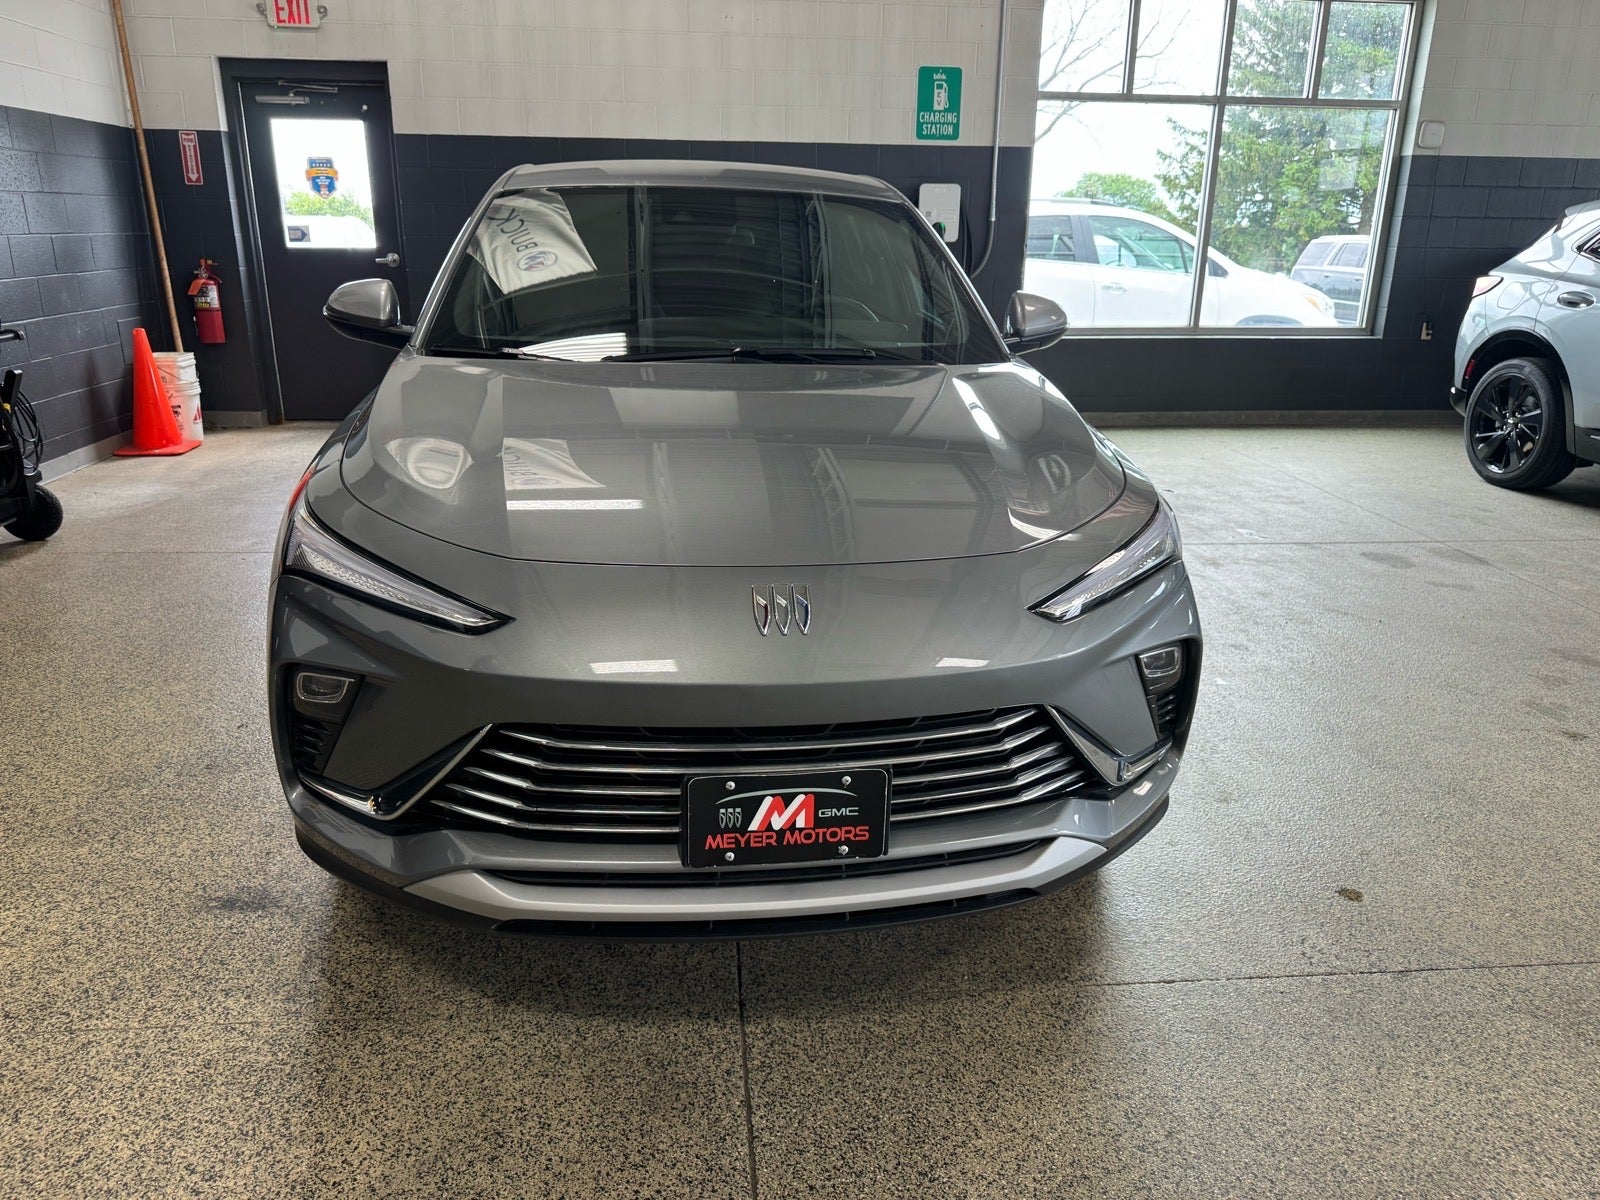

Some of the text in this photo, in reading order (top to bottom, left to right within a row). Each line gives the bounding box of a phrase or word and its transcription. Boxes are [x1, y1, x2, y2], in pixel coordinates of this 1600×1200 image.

[919, 112, 958, 123] CHARGING
[922, 124, 953, 135] STATION
[818, 806, 859, 818] GMC
[705, 826, 869, 849] MEYER MOTORS
